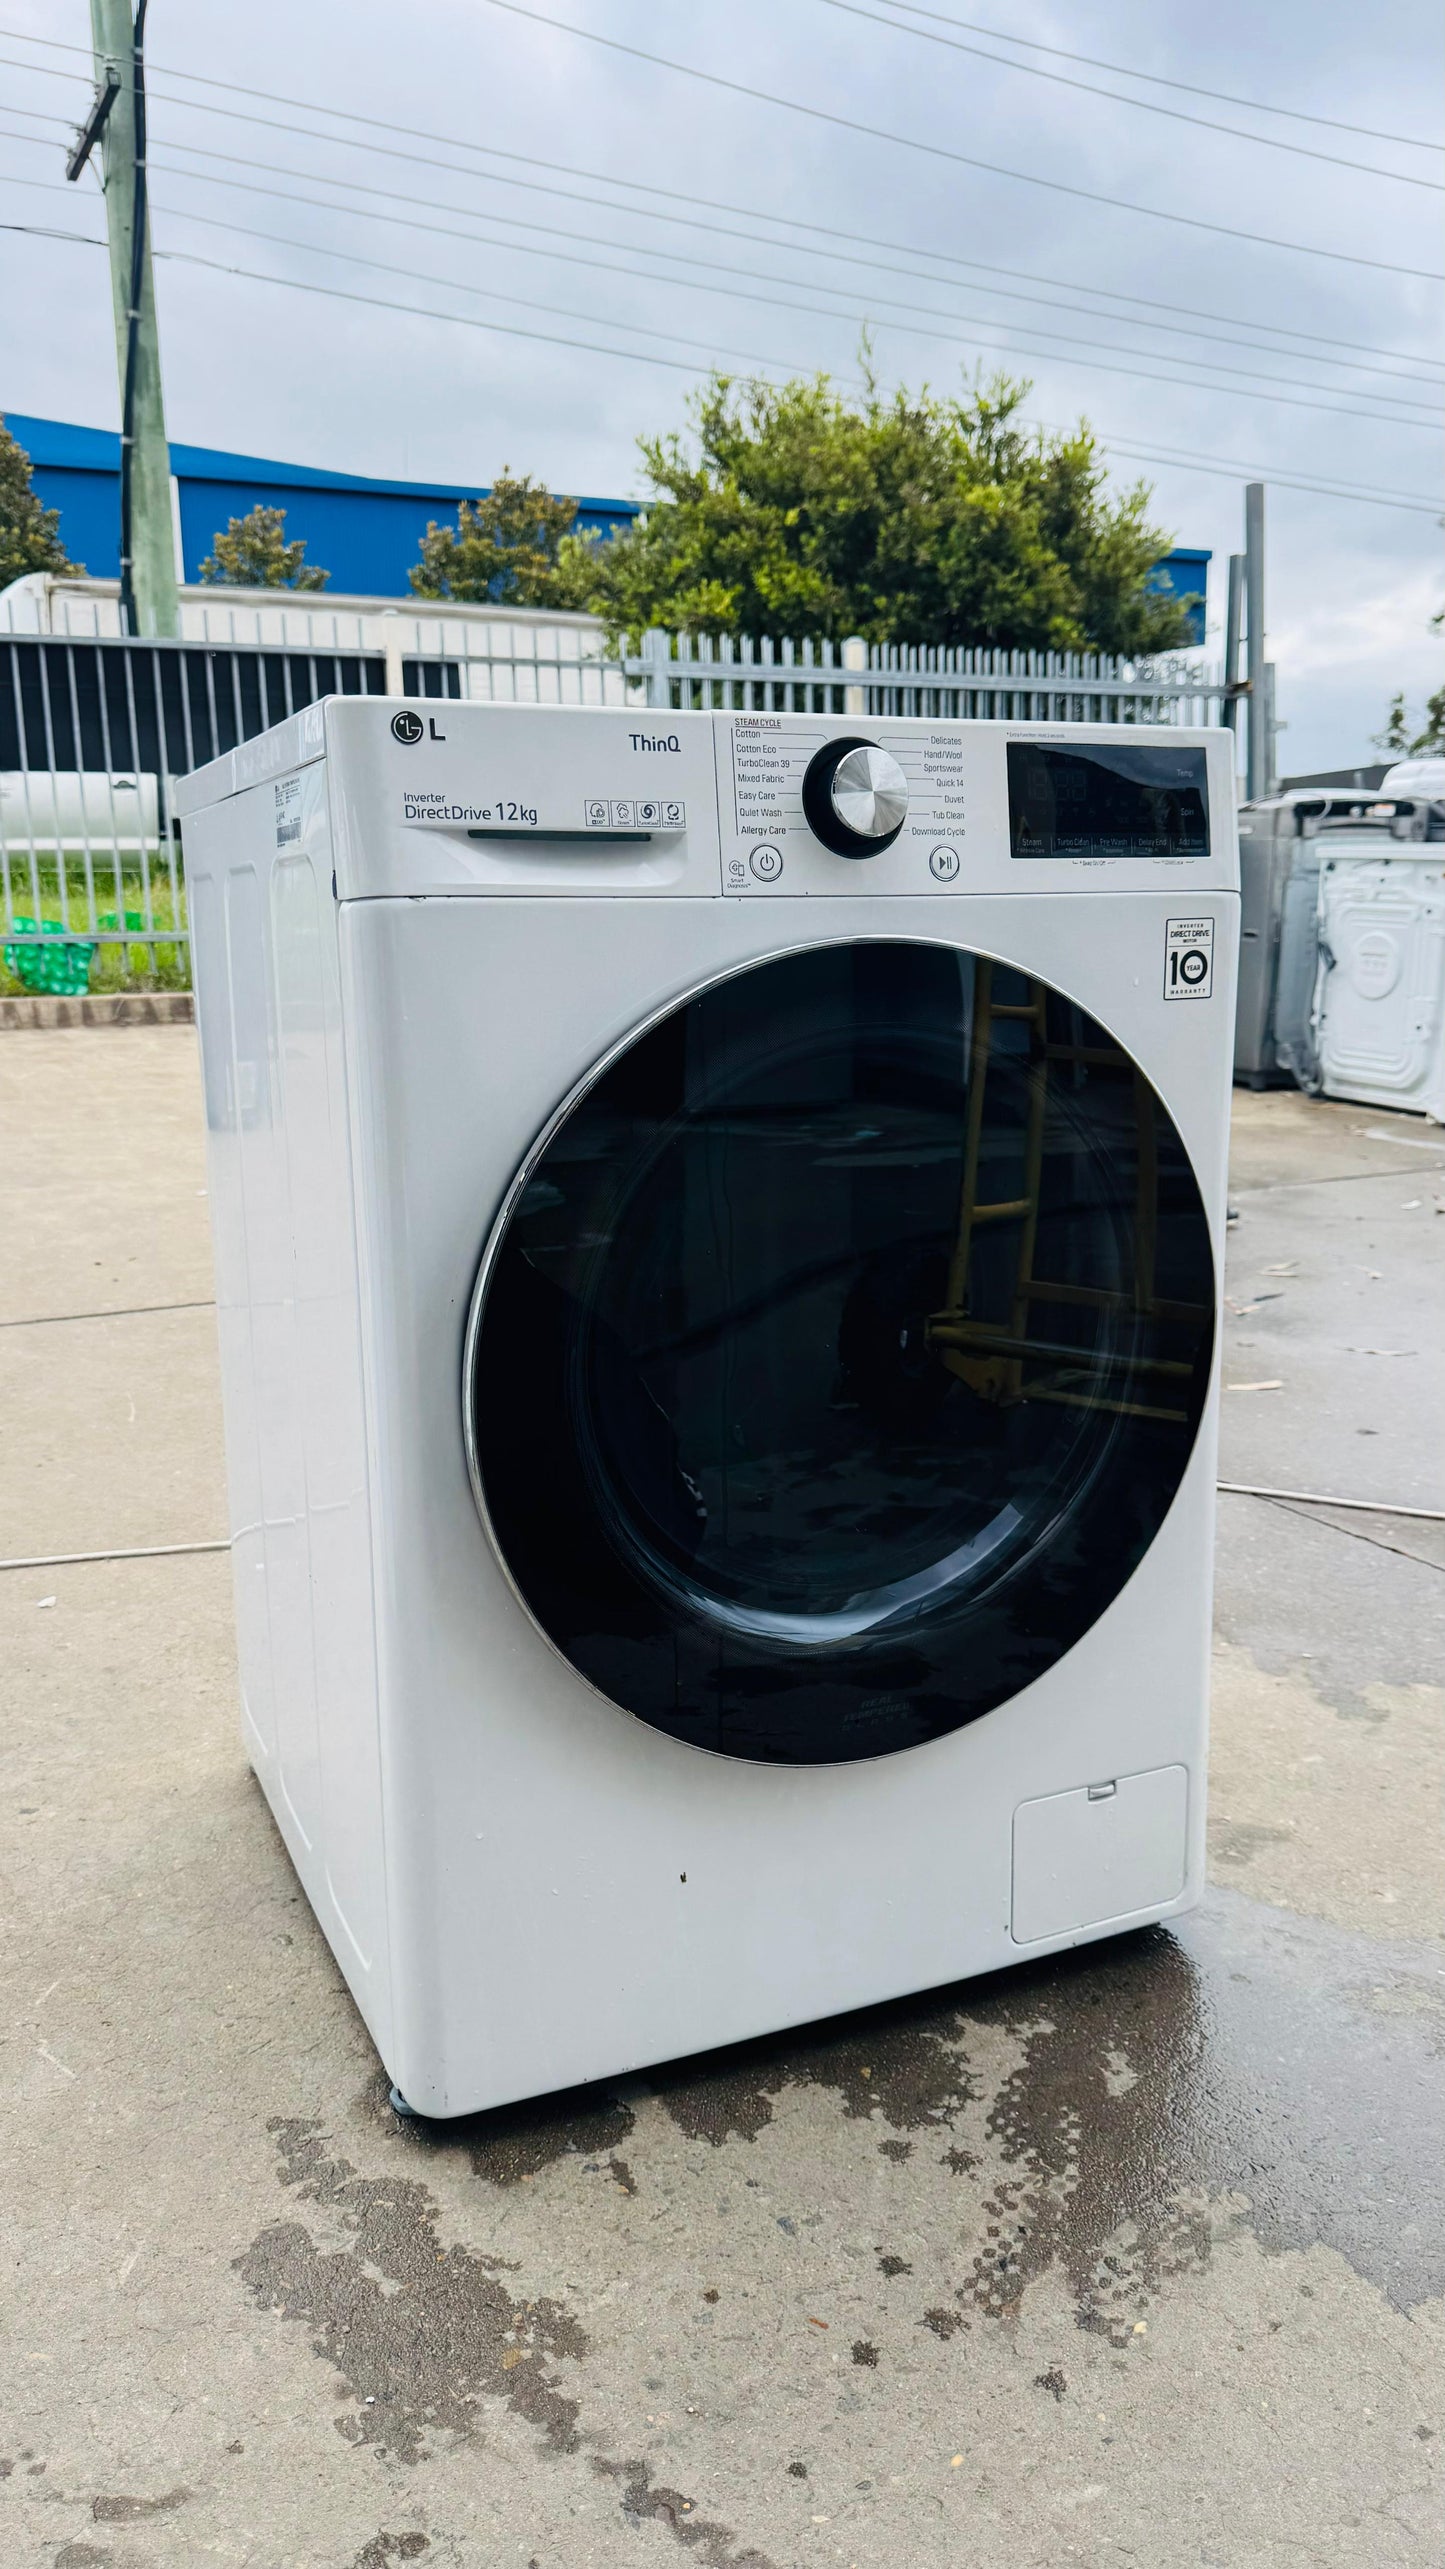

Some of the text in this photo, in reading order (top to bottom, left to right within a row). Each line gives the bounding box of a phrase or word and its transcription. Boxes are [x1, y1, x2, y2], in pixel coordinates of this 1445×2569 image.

[735, 718, 782, 728] STEAM CYCLE
[735, 729, 761, 738] Cotton
[629, 734, 681, 753] ThinQ
[930, 736, 962, 746] Delicates
[736, 743, 777, 754] Cotton Eco
[924, 750, 963, 760] Hand/Wool
[737, 758, 790, 768] TurboClean 39
[923, 763, 963, 774] Sportswear
[738, 774, 785, 783] Mixed Fabric
[936, 778, 964, 788] Quick 14
[403, 792, 446, 804] Inverter
[738, 791, 776, 801] Easy Care
[944, 795, 965, 804] Duvet
[495, 802, 538, 826] 12kg
[739, 808, 782, 818] Quiet Wash
[932, 811, 965, 820] Tub Clean
[1180, 807, 1195, 817] Spin
[741, 826, 787, 837] Allergy Care
[911, 828, 966, 837] Download Cycle
[1170, 930, 1191, 938] DIRECT
[1170, 950, 1208, 985] 10
